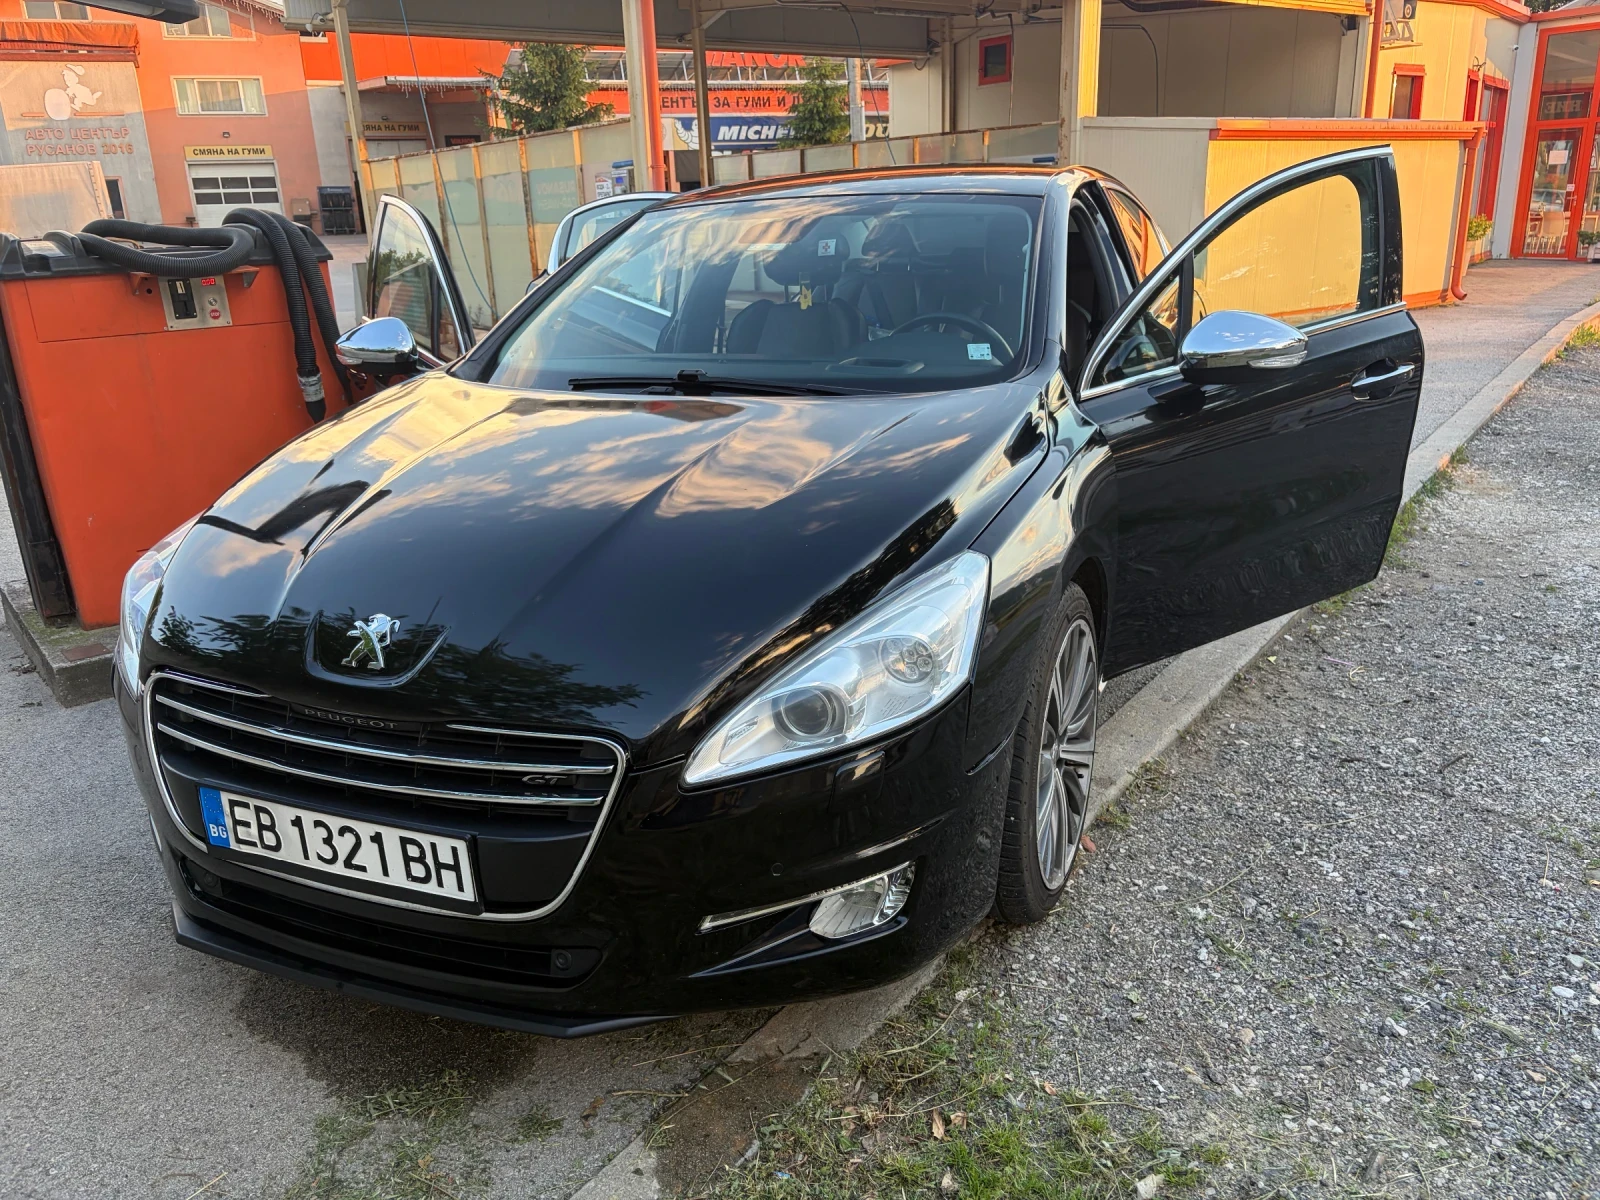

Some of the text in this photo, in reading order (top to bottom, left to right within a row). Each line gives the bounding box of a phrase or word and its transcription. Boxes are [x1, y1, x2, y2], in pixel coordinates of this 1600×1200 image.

[713, 96, 731, 108] ЗА
[736, 96, 771, 108] ГУМИ
[777, 96, 786, 107] И
[25, 126, 130, 141] АВТО ЦЕНТЪР
[384, 124, 396, 132] НА
[398, 124, 420, 132] ГУМИ
[26, 142, 134, 156] РУСАНОВ 2016
[192, 148, 225, 156] СМЯНА
[242, 147, 266, 155] ГУМИ
[304, 708, 398, 729] PEUGEOT
[521, 774, 568, 785] GT
[209, 822, 227, 840] BG
[228, 798, 465, 892] EB 1321 BH
